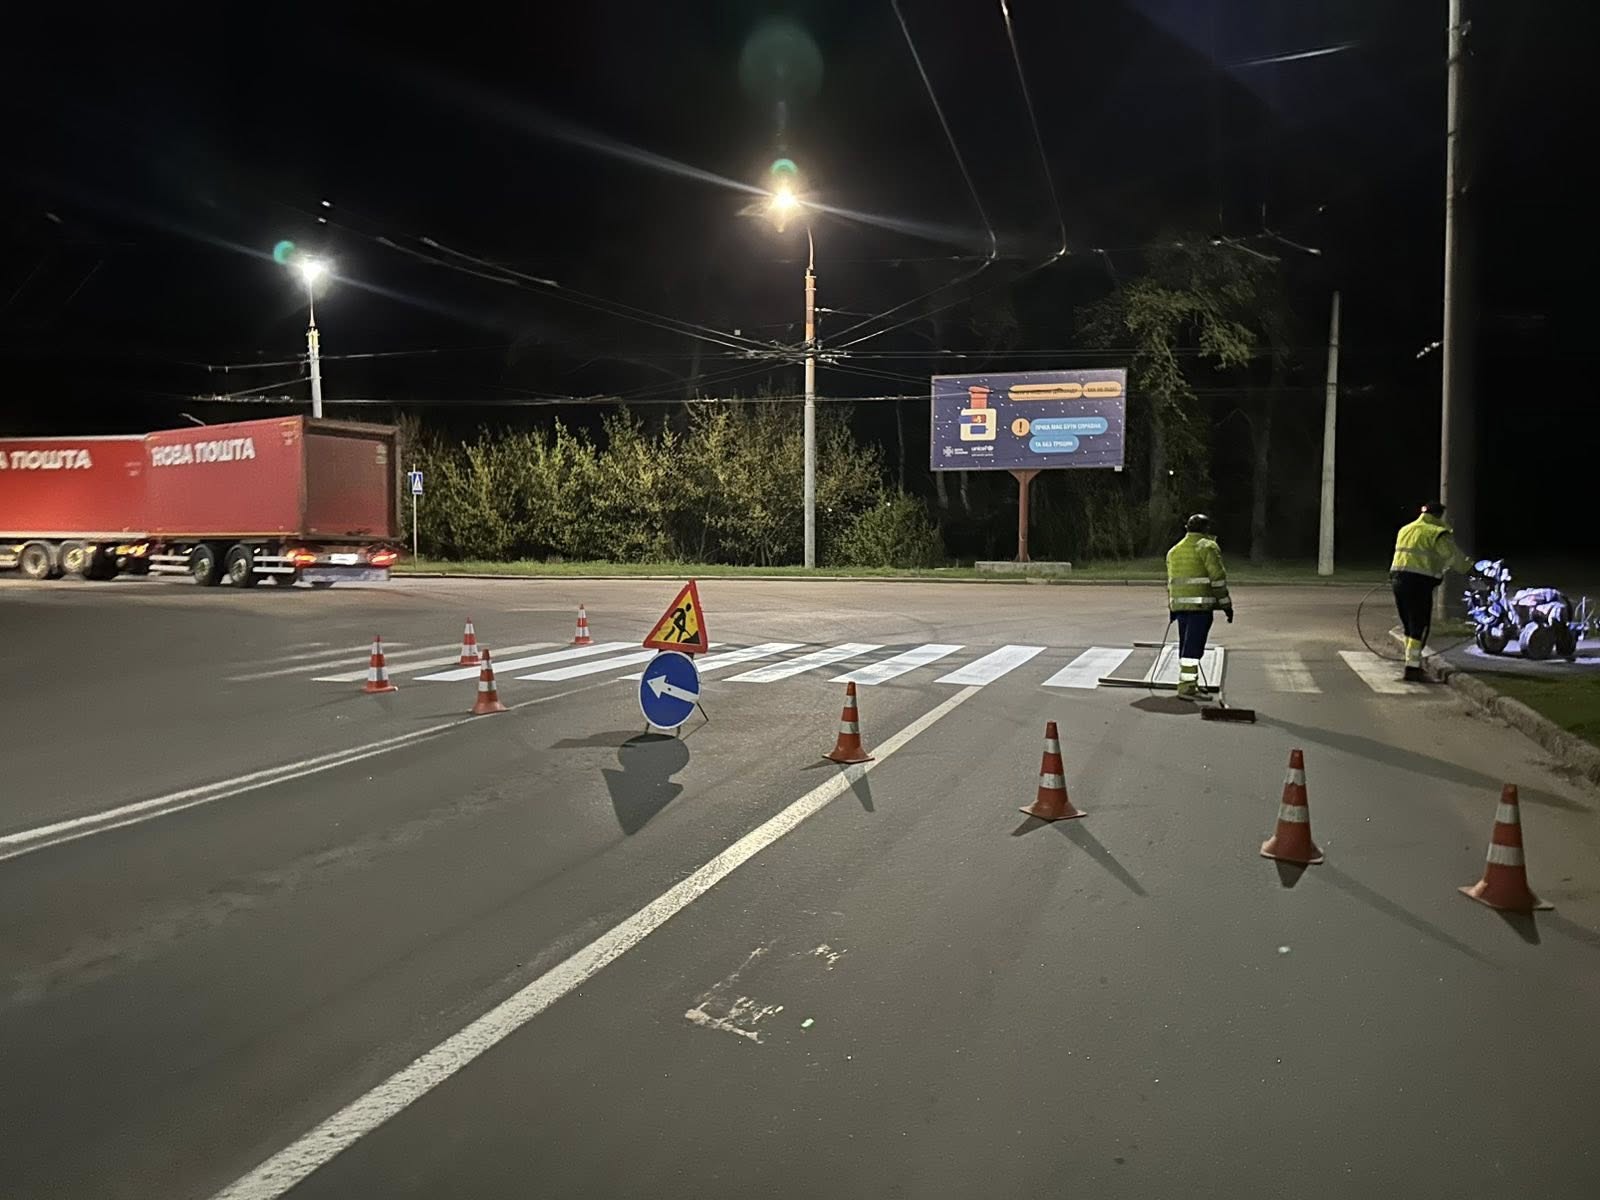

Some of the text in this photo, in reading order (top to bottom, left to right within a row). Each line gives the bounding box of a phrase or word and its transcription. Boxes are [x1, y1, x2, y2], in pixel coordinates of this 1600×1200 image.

[10, 449, 92, 470] ПОШТА
[152, 444, 194, 466] НОВА
[194, 438, 256, 464] ПОШТА
